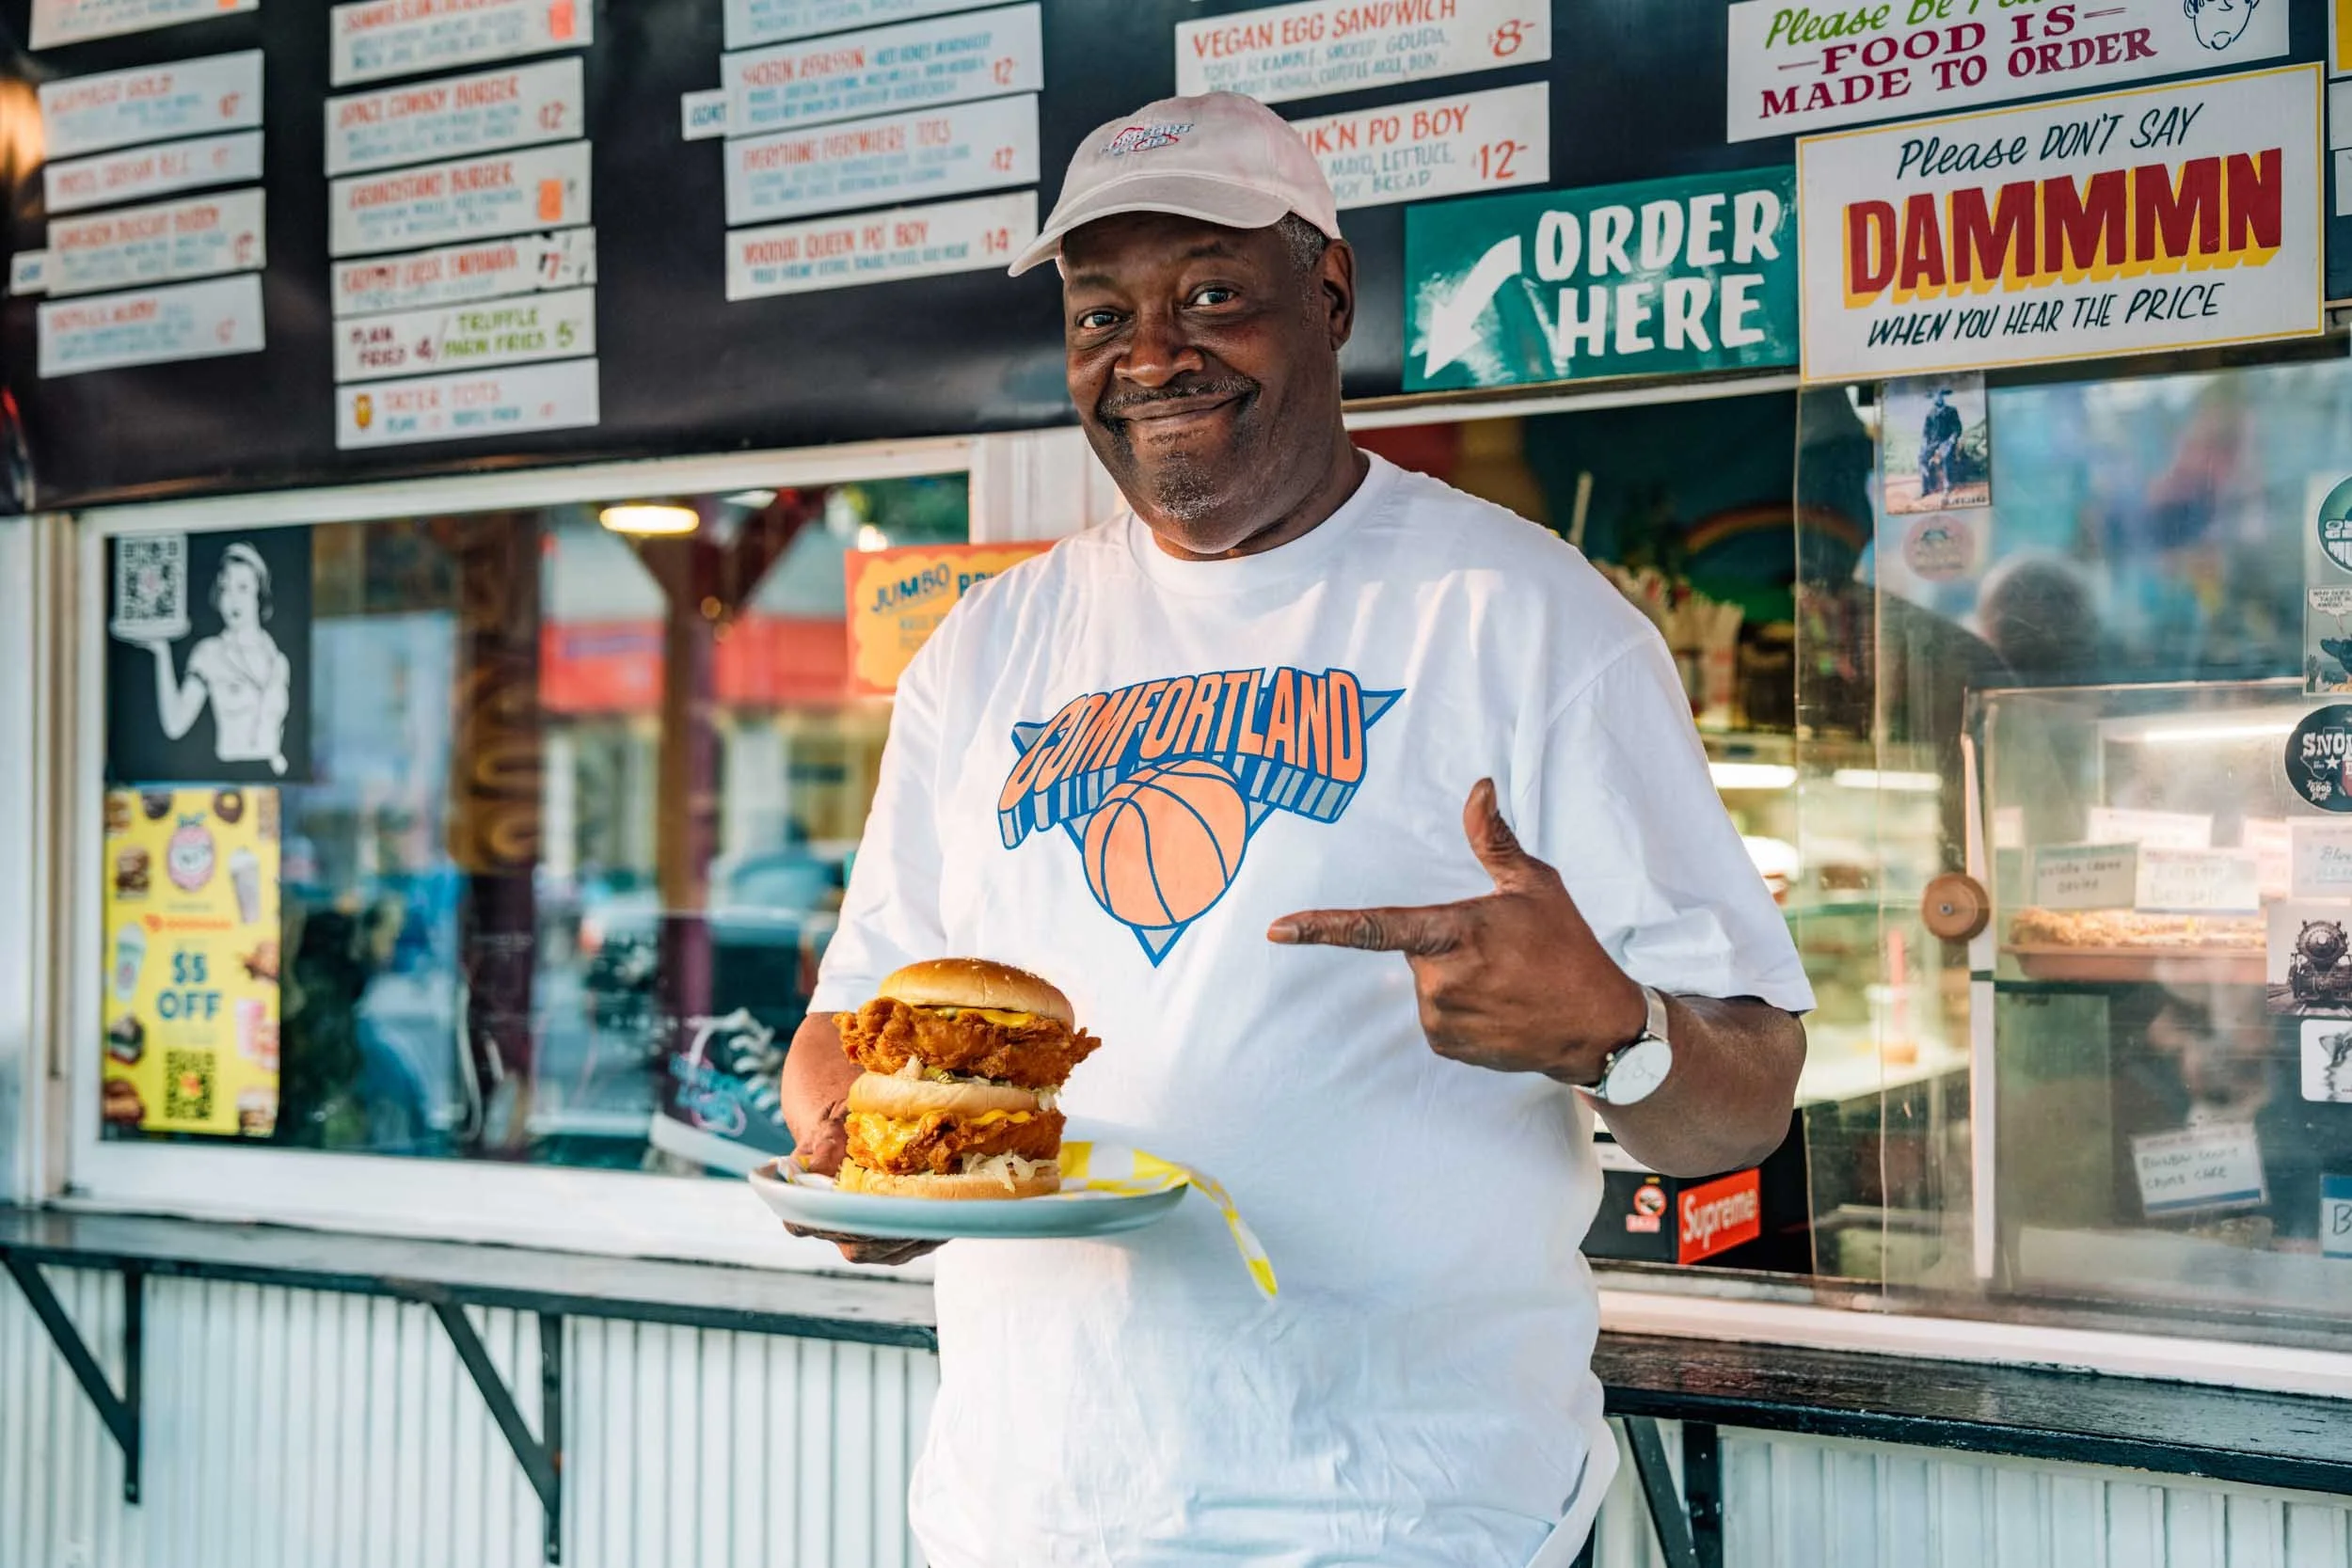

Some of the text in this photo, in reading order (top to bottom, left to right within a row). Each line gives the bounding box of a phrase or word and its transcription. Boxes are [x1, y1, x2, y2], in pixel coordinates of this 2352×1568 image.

[1193, 0, 1455, 59] VEGAN EGG SANDWICH
[1766, 4, 1890, 49] Please
[1822, 4, 2076, 74] FOOD IS
[453, 75, 520, 110] BURGER
[1759, 28, 2158, 119] MADE TO ORDER
[1412, 103, 1470, 140] BOY
[1897, 102, 2206, 182] Please DON'T SAY
[804, 230, 856, 260] QUEEN
[895, 220, 930, 247] BOY
[1534, 189, 1782, 282] ORDER
[1843, 147, 2283, 303] DAMMMN
[457, 309, 539, 332] TRUFFLE
[495, 331, 547, 352] FRIES
[1557, 273, 1766, 358] HERE
[1867, 282, 2228, 350] WHEN YOU HEAR THE PRICE
[871, 562, 951, 613] JUMBO
[998, 666, 1368, 837] COMFORTLAND
[171, 951, 208, 986] $5
[156, 990, 223, 1021] OFF
[1682, 1187, 1759, 1251] Supreme
